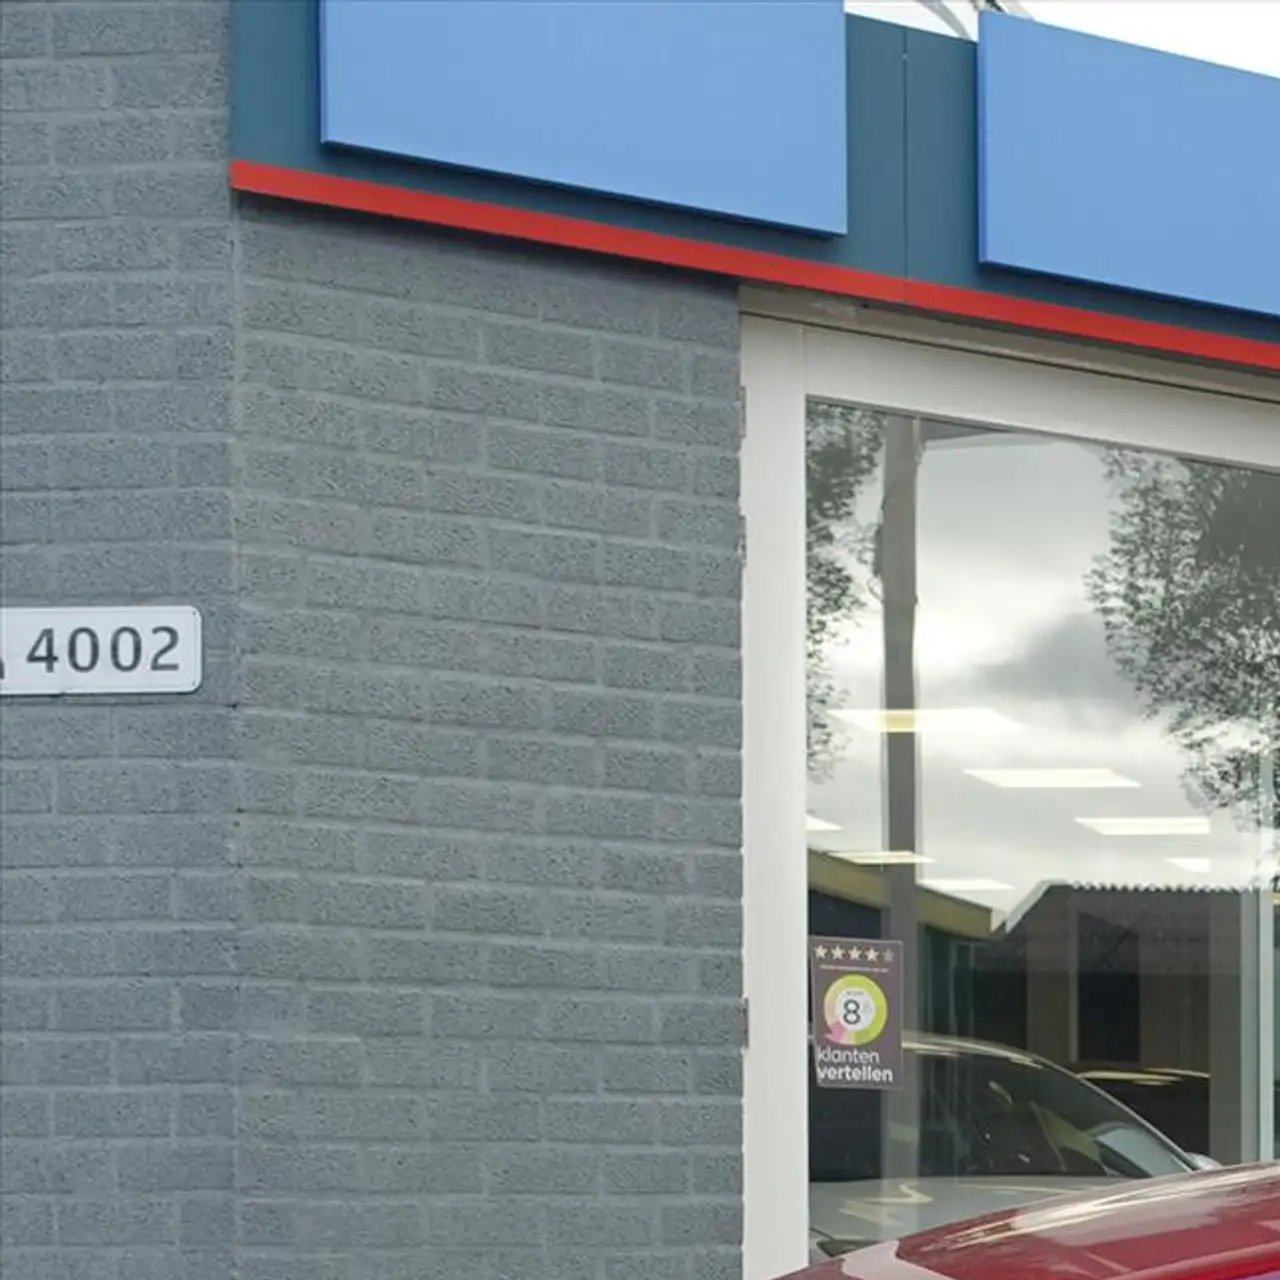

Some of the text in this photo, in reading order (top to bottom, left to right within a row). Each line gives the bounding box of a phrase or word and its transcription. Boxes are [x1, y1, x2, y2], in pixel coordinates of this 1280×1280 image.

[26, 625, 181, 674] 4002
[816, 1045, 880, 1064] klanten
[816, 1065, 893, 1083] vertellen
